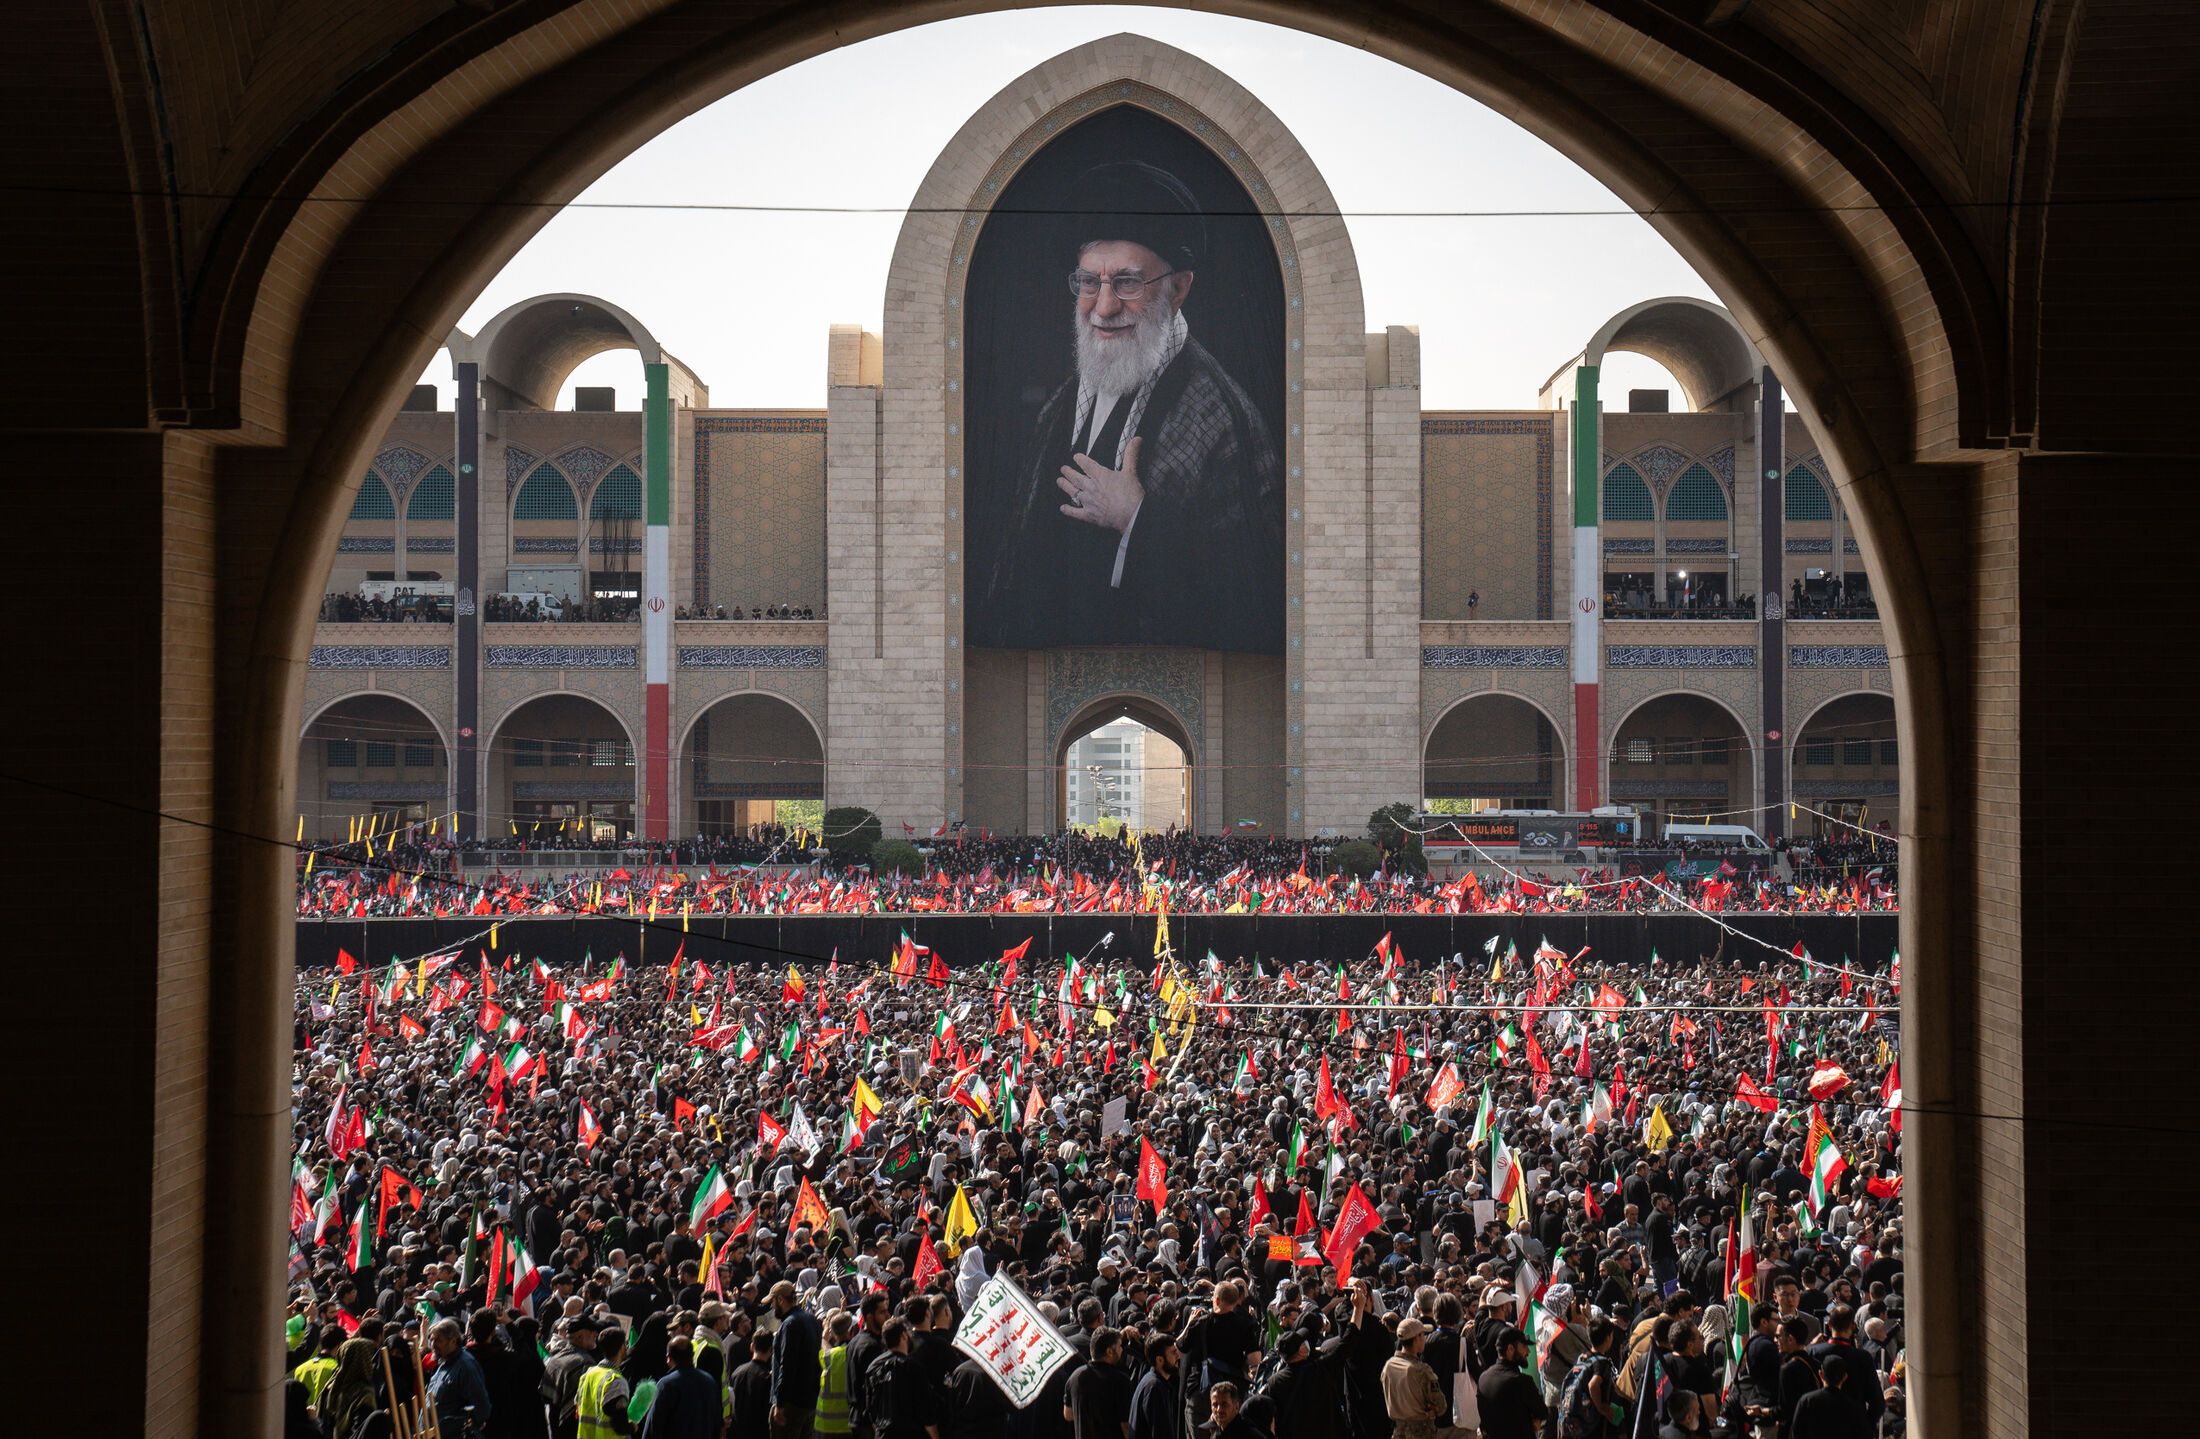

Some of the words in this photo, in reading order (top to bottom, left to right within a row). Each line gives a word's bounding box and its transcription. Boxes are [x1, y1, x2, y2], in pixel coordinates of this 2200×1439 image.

[394, 586, 416, 596] CAT
[1459, 824, 1515, 835] AMBULANCE
[986, 1284, 1007, 1307] الله
